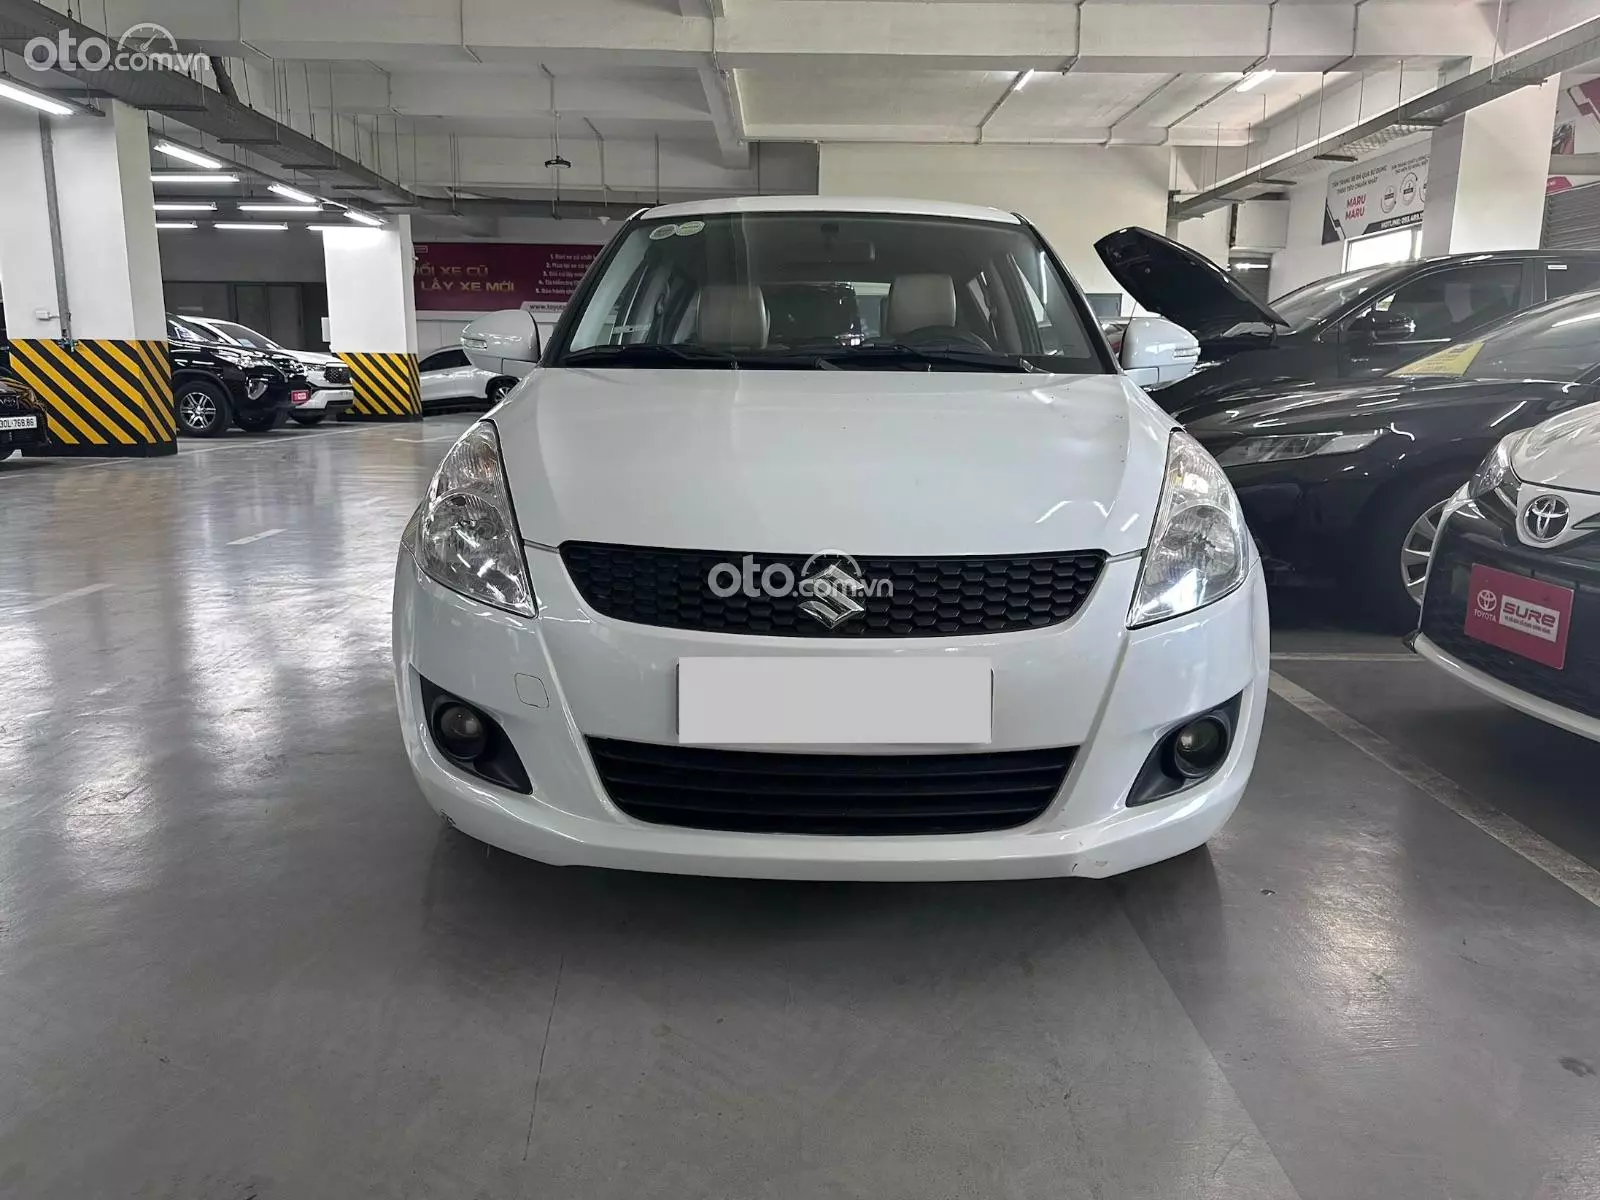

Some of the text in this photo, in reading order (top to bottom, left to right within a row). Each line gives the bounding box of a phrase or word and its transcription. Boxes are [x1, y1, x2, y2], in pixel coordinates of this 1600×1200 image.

[1346, 194, 1367, 208] MARU
[1345, 207, 1366, 220] MARU
[440, 266, 462, 276] XE
[466, 264, 489, 276] CŨ
[420, 277, 515, 292] LẤY XE MỚI
[1473, 609, 1497, 622] TOYOTA
